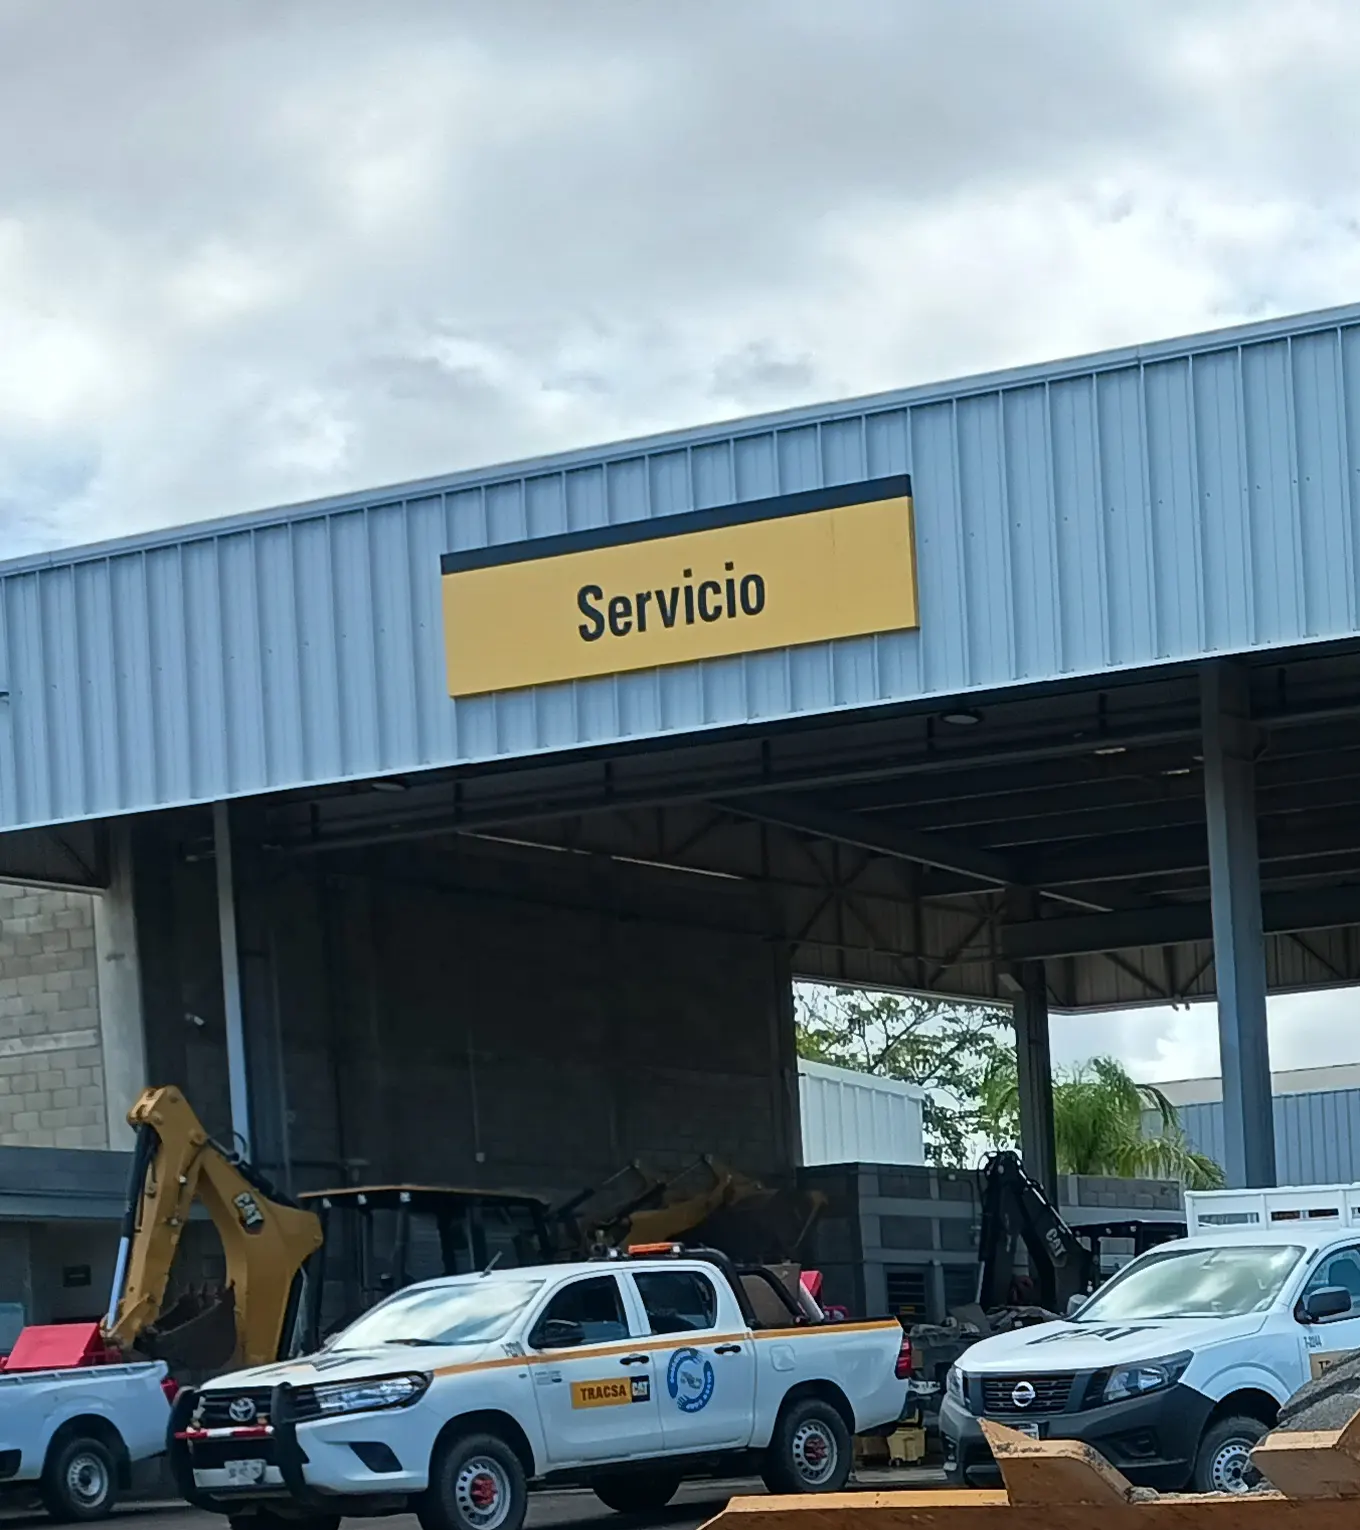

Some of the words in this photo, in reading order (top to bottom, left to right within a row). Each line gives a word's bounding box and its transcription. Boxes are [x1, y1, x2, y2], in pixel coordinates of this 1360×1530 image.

[577, 561, 766, 642] Servicio
[233, 1192, 264, 1225] CAT
[1045, 1227, 1067, 1257] CAT
[579, 1384, 627, 1401] TRACSA
[631, 1380, 649, 1397] CAT
